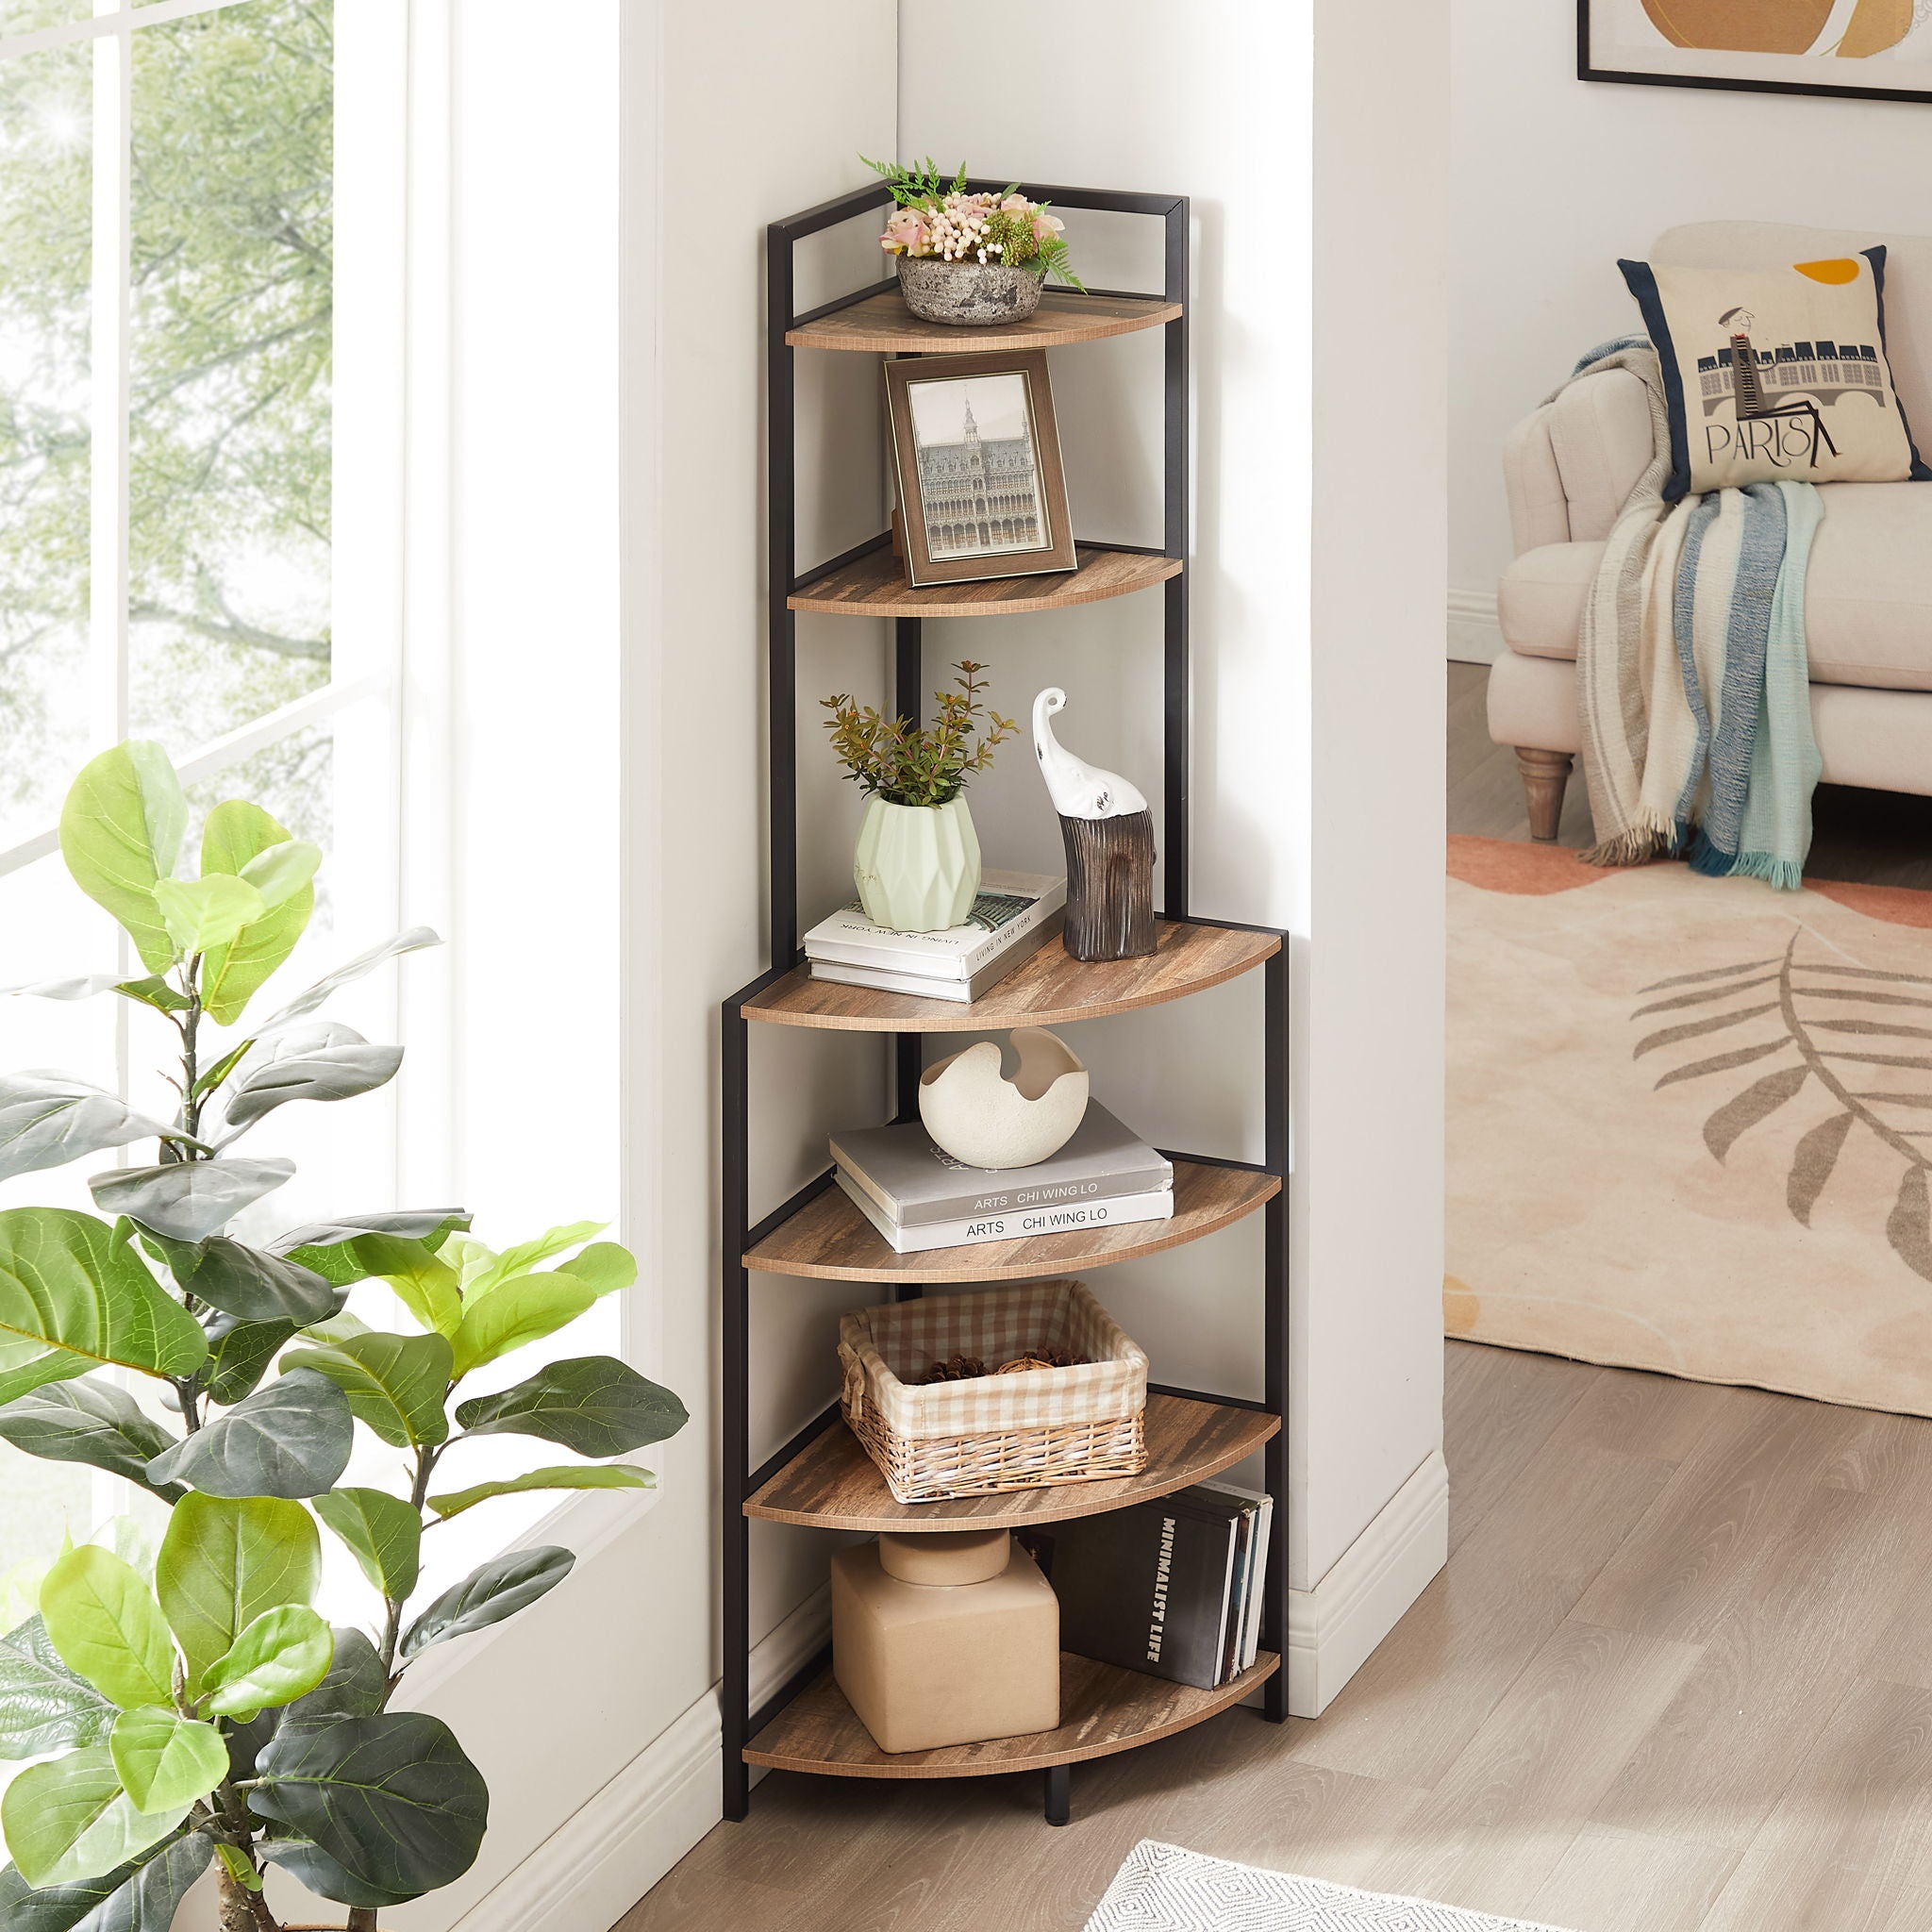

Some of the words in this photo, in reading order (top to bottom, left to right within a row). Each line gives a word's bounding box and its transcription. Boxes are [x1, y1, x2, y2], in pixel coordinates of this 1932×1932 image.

[1705, 417, 1811, 468] PARIS
[841, 924, 872, 934] YORK
[975, 942, 994, 961] LIVING
[995, 937, 1003, 946] IN
[1003, 928, 1015, 940] NEW
[1017, 915, 1032, 928] YORK
[974, 1195, 1008, 1210] ARTS
[1017, 1191, 1040, 1204] CHI
[1042, 1185, 1077, 1200] WING
[1080, 1182, 1098, 1194] LO
[966, 1221, 1005, 1238] ARTS
[1023, 1216, 1045, 1230] CHI
[1049, 1210, 1086, 1226] WING
[1090, 1208, 1108, 1221] LO
[1152, 1517, 1175, 1622] MINIMALIST
[1147, 1624, 1163, 1662] LIFE
